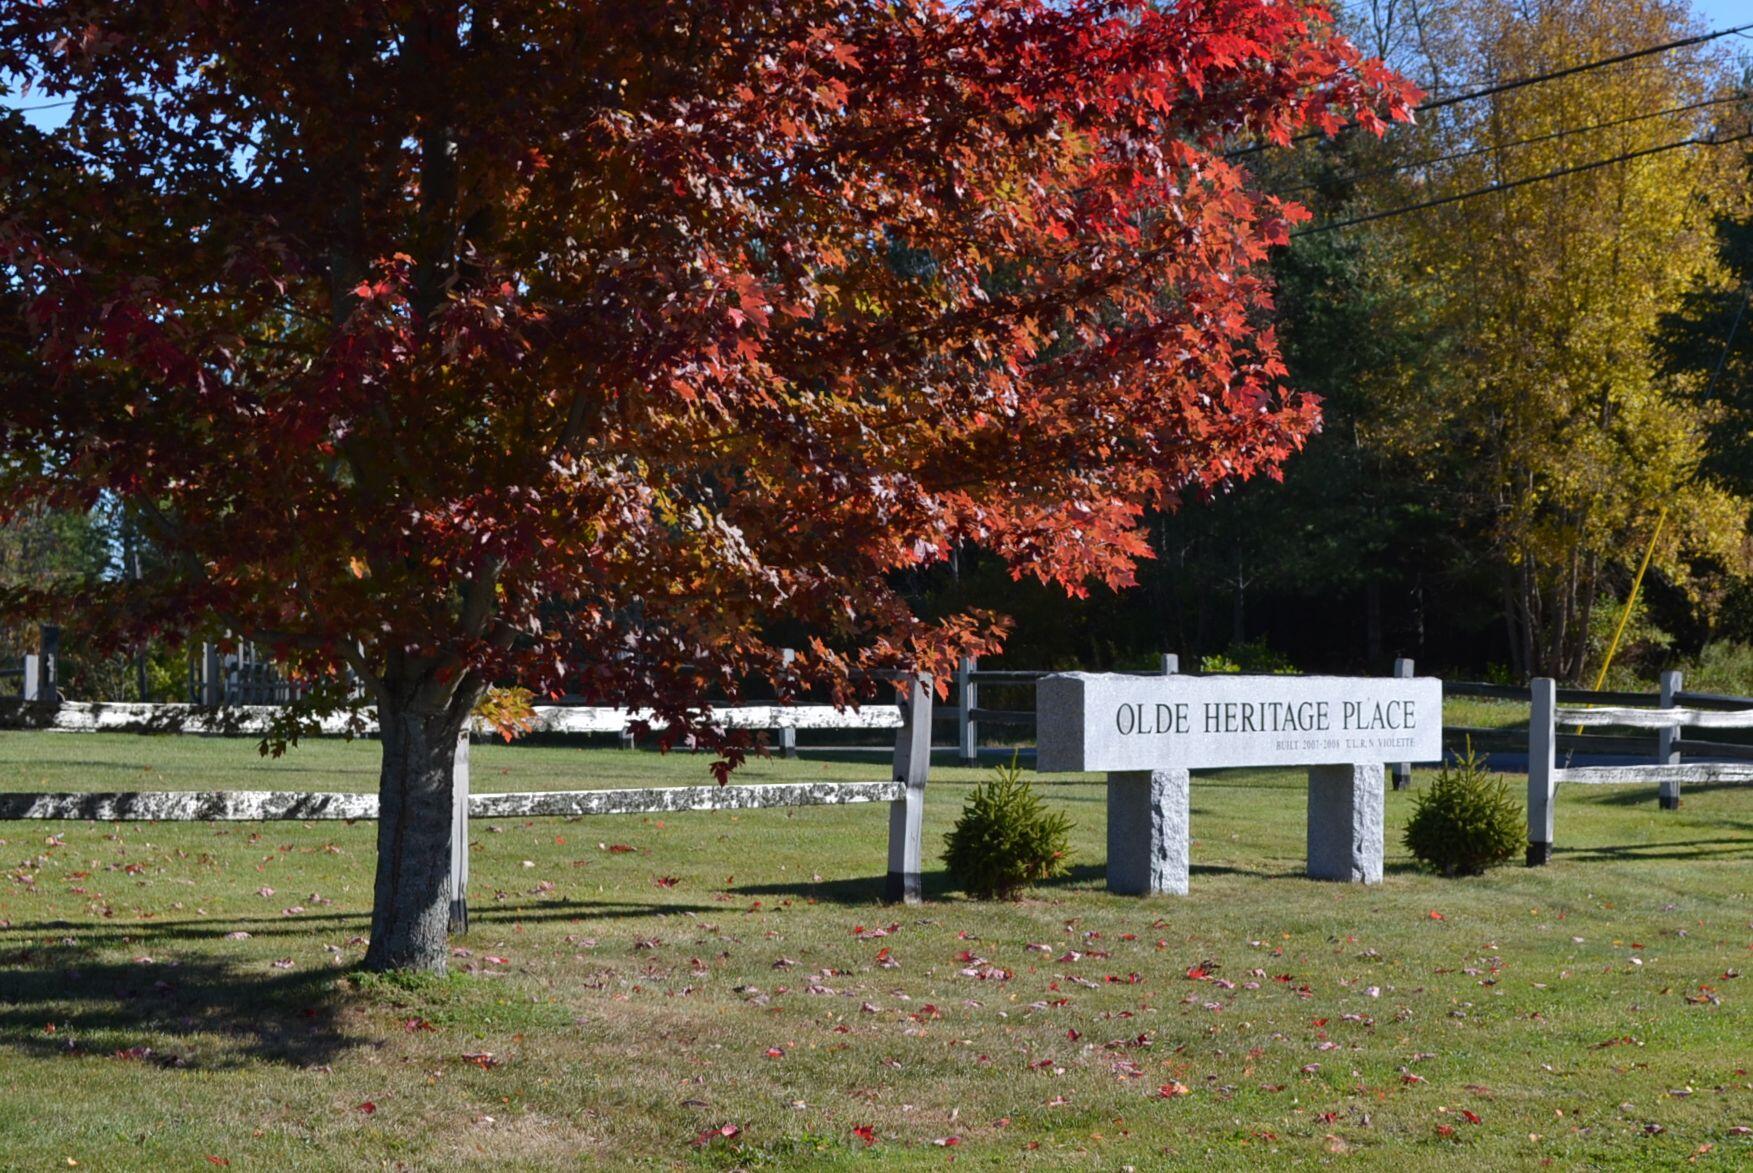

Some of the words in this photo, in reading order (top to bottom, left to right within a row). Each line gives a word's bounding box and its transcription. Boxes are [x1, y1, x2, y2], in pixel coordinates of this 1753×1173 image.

[1115, 702, 1191, 736] OLDE
[1203, 701, 1330, 733] HERITAGE
[1342, 700, 1416, 730] PLACE
[1275, 740, 1299, 751] BUILT
[1378, 737, 1416, 748] VIOLETTE
